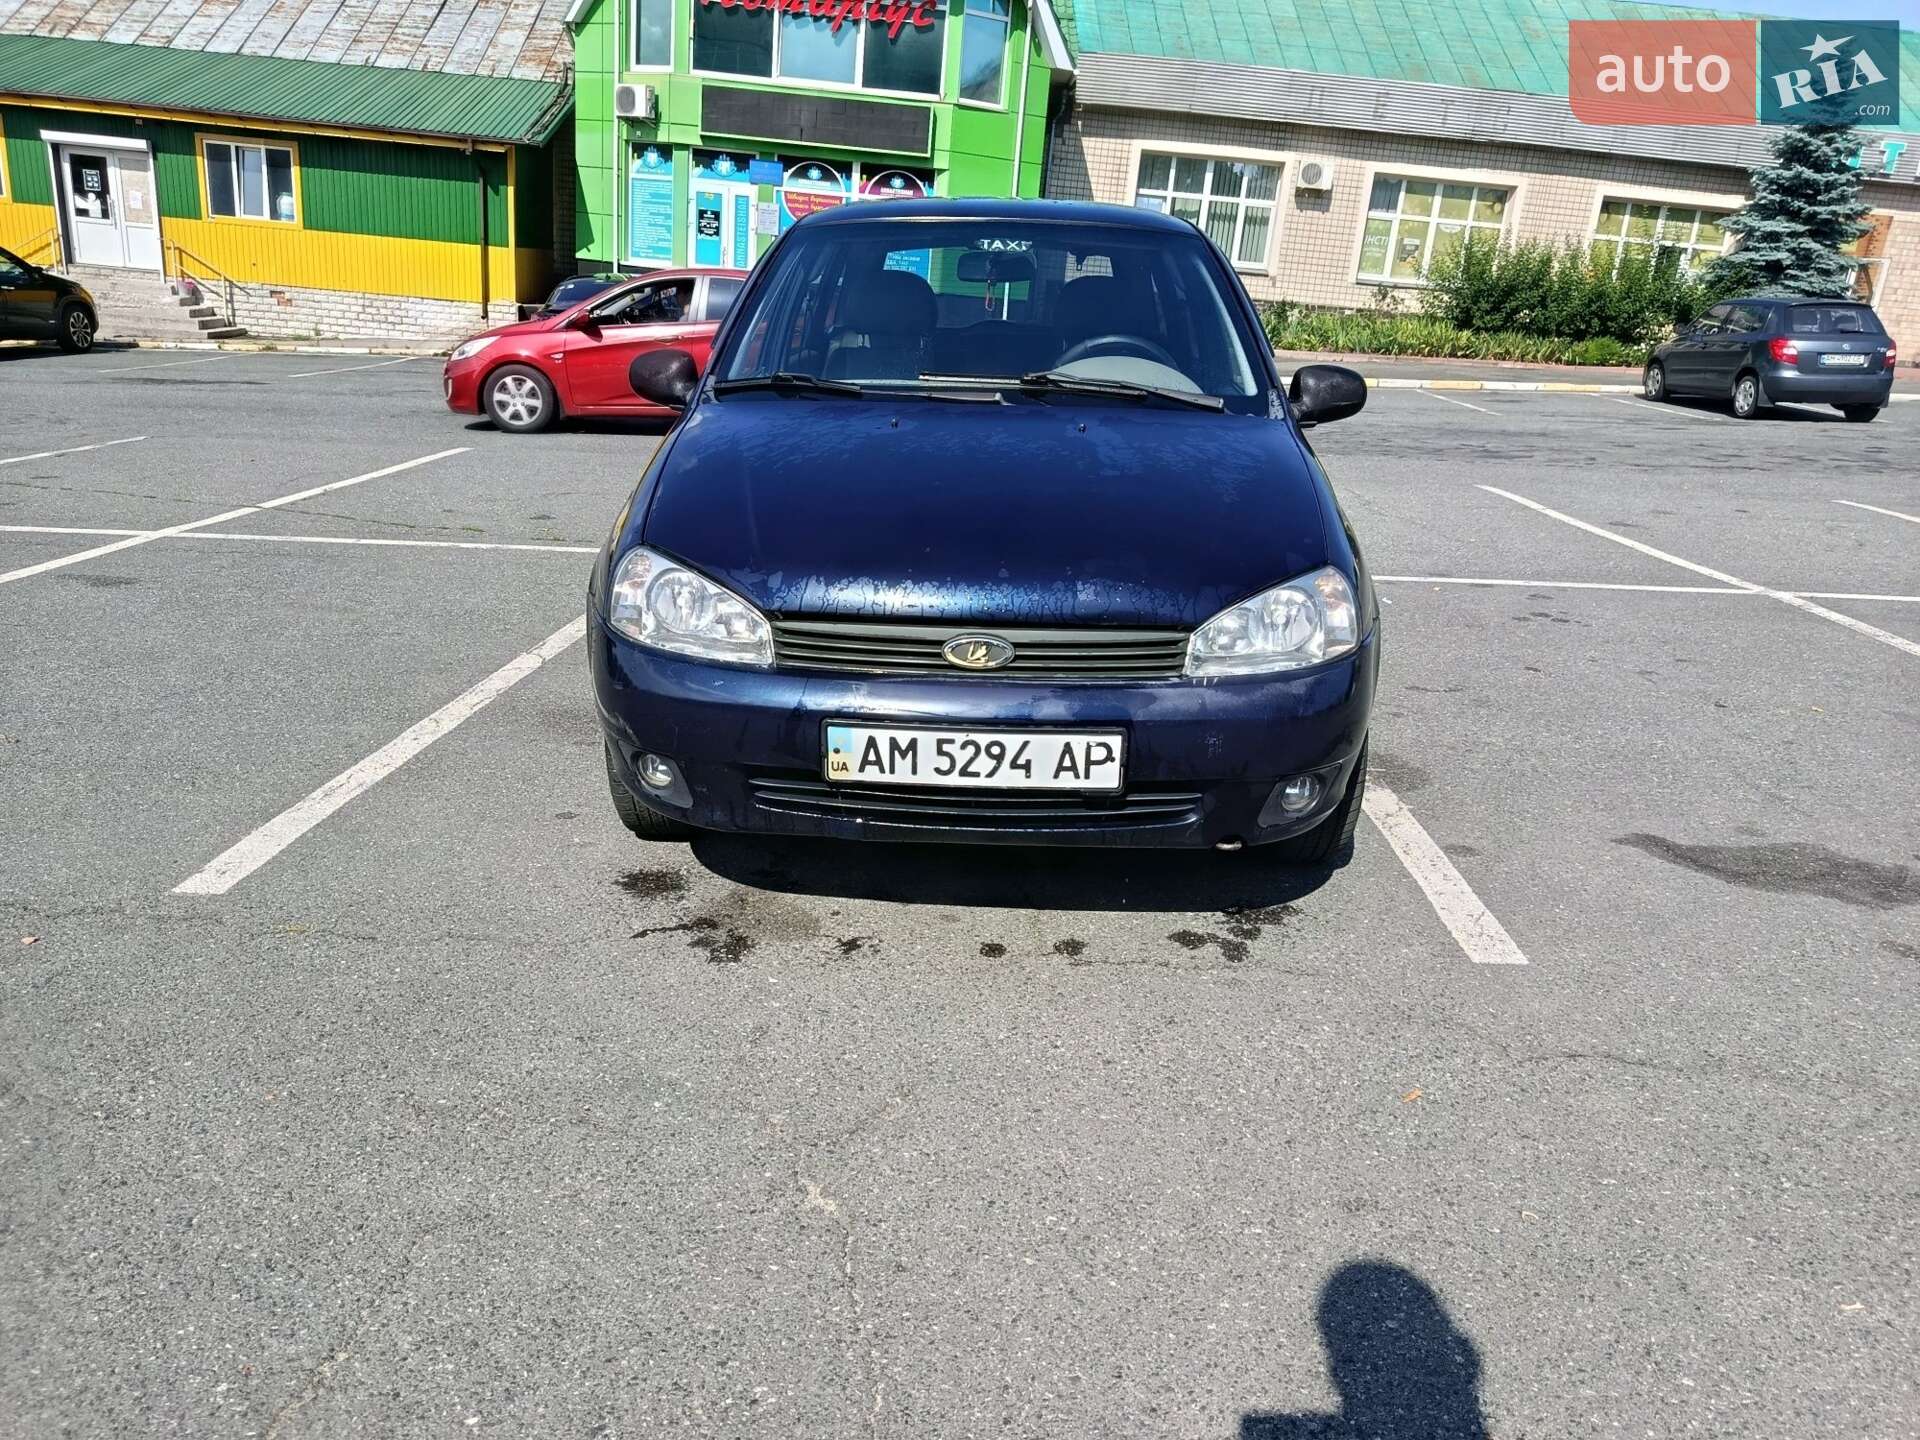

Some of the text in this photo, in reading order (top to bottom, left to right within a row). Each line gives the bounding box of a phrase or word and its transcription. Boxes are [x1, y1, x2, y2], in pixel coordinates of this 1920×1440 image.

[831, 761, 849, 772] UA
[858, 735, 1116, 780] AM 5294 AP
